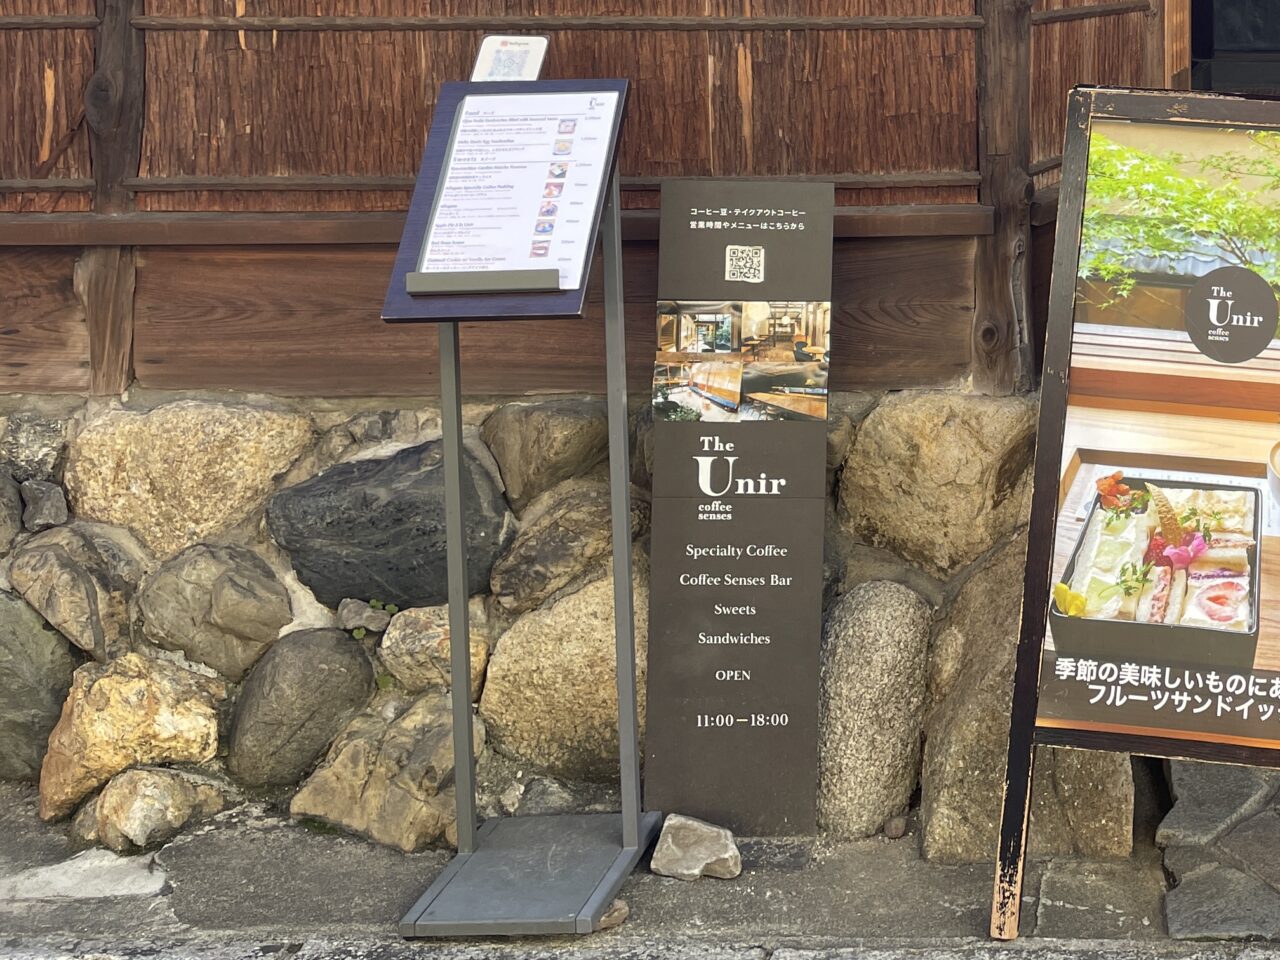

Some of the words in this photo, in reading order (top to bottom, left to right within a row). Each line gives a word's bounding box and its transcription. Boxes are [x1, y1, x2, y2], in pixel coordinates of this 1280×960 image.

[690, 207, 806, 217] コーヒー豆・テイクアウトコーヒー
[689, 220, 805, 231] 営業時間やメニューはこちらから
[1211, 286, 1233, 297] The
[1206, 298, 1264, 327] Unir
[1208, 327, 1230, 336] coffee
[699, 436, 735, 452] The
[692, 456, 787, 497] Unir
[698, 501, 733, 512] coffee
[698, 512, 732, 521] senses
[685, 544, 743, 560] Specialty
[746, 544, 788, 558] Coffee
[679, 573, 722, 586] Coffee
[723, 573, 766, 586] Senses
[770, 574, 793, 586] Bar
[714, 603, 757, 615] Sweets
[698, 632, 771, 645] Sandwiches
[715, 670, 751, 681] OPEN
